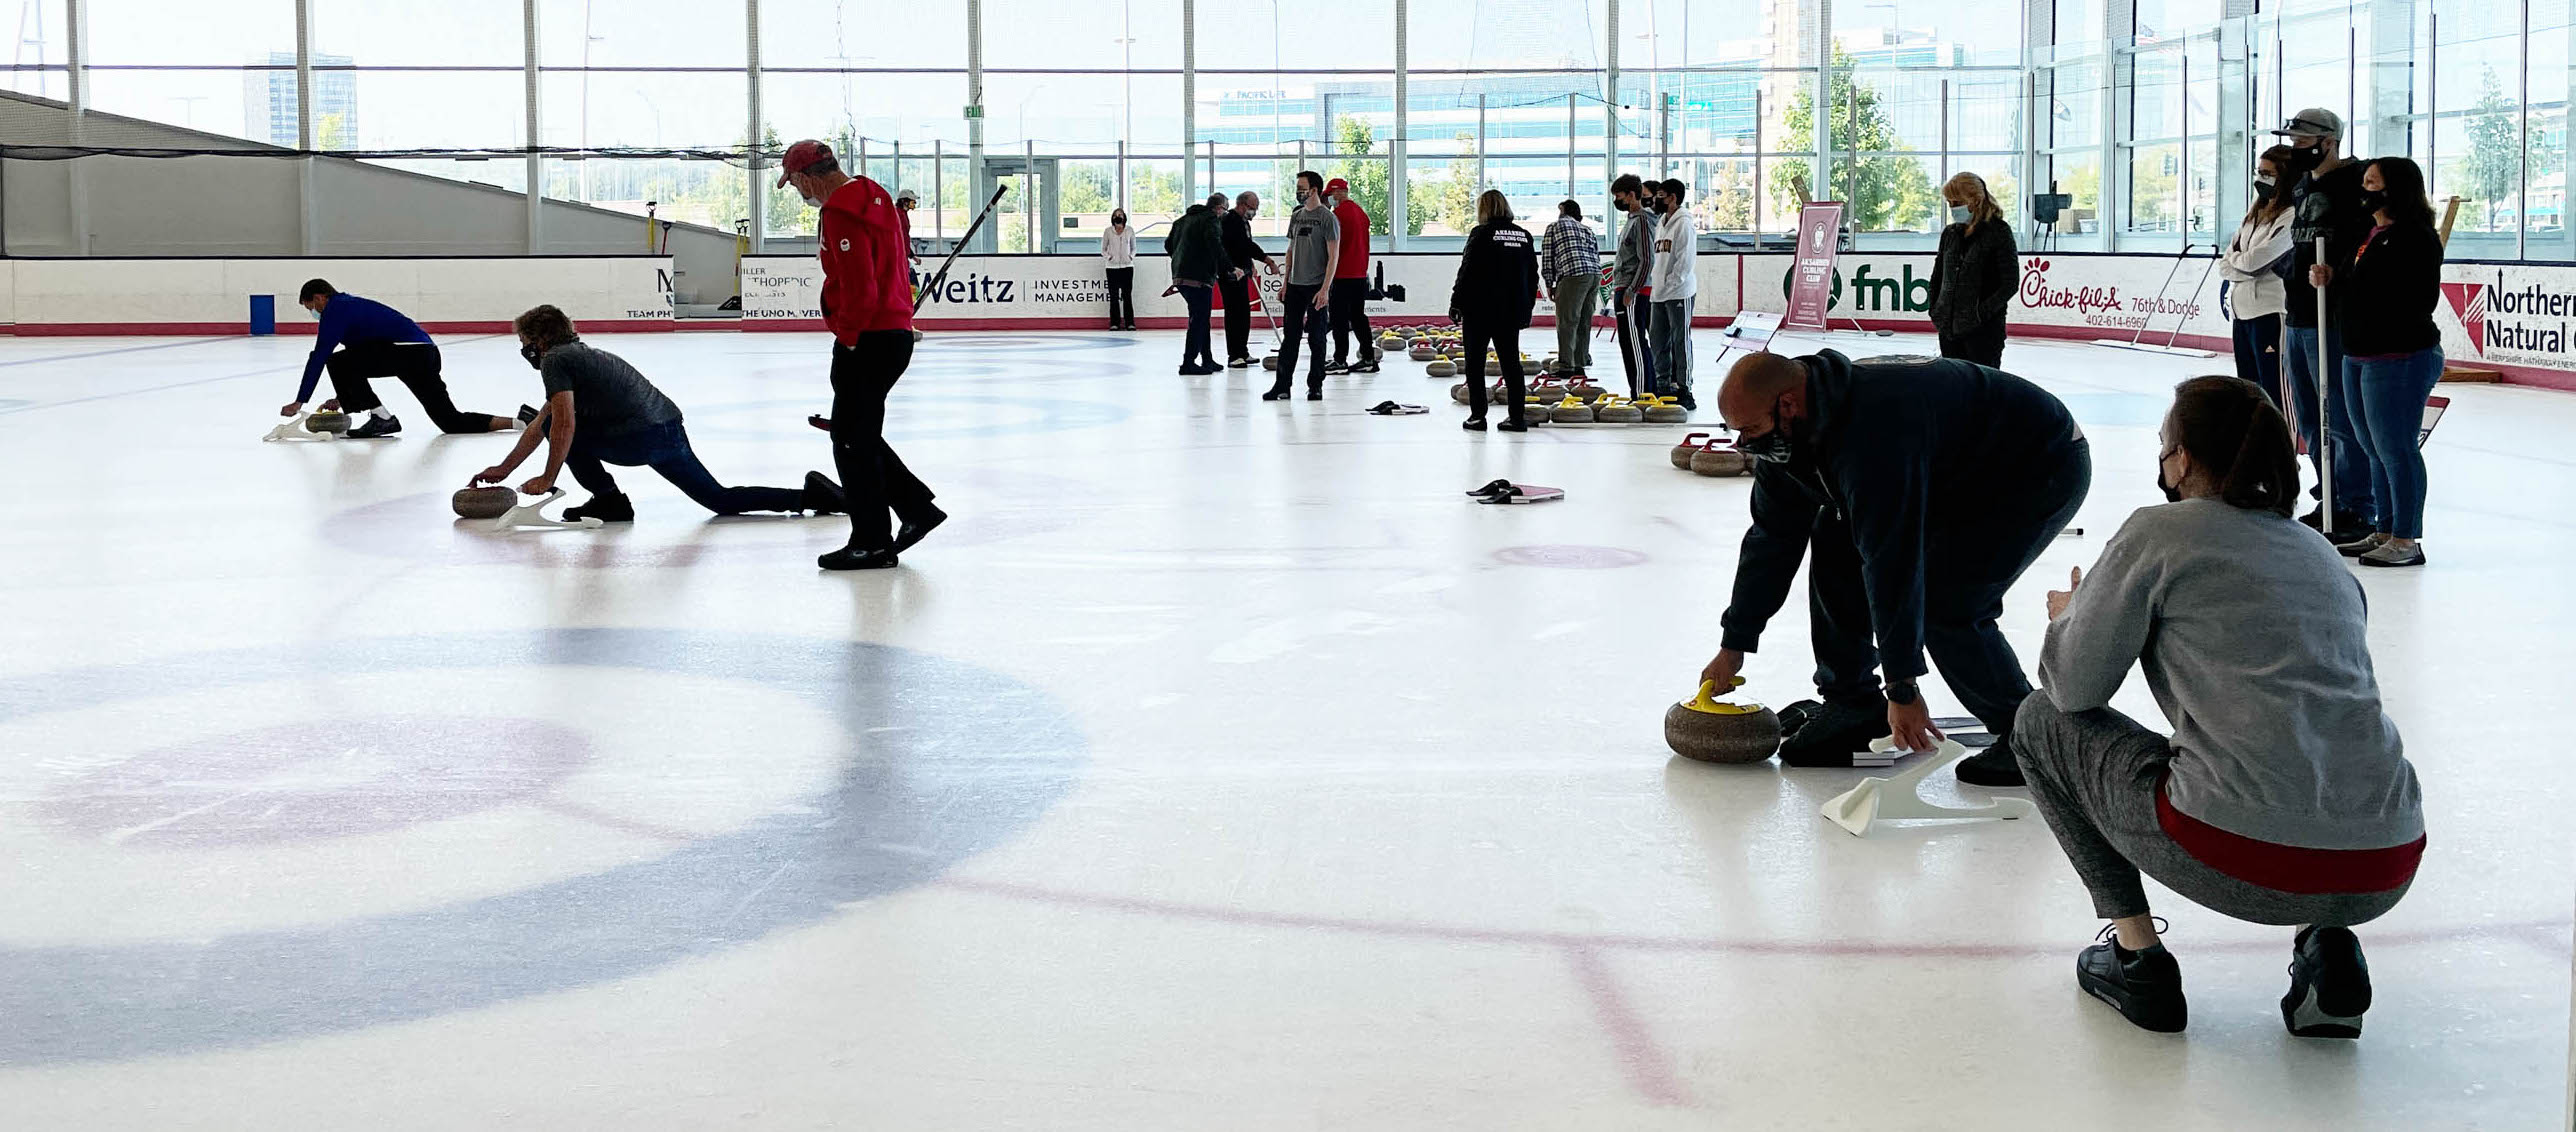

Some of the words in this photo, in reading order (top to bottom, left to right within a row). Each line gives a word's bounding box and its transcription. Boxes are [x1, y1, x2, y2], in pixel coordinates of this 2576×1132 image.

[914, 272, 1014, 303] Weitz
[1034, 280, 1109, 290] INVESTME
[1034, 292, 1111, 302] MANAGEME
[2020, 268, 2122, 314] Chick-fil-A
[2131, 297, 2156, 313] 76th
[2157, 299, 2166, 314] &
[2168, 298, 2200, 320] Dodge
[627, 310, 655, 318] TEAM
[657, 310, 673, 318] PH
[761, 309, 785, 318] UNO
[2486, 319, 2566, 353] Natural
